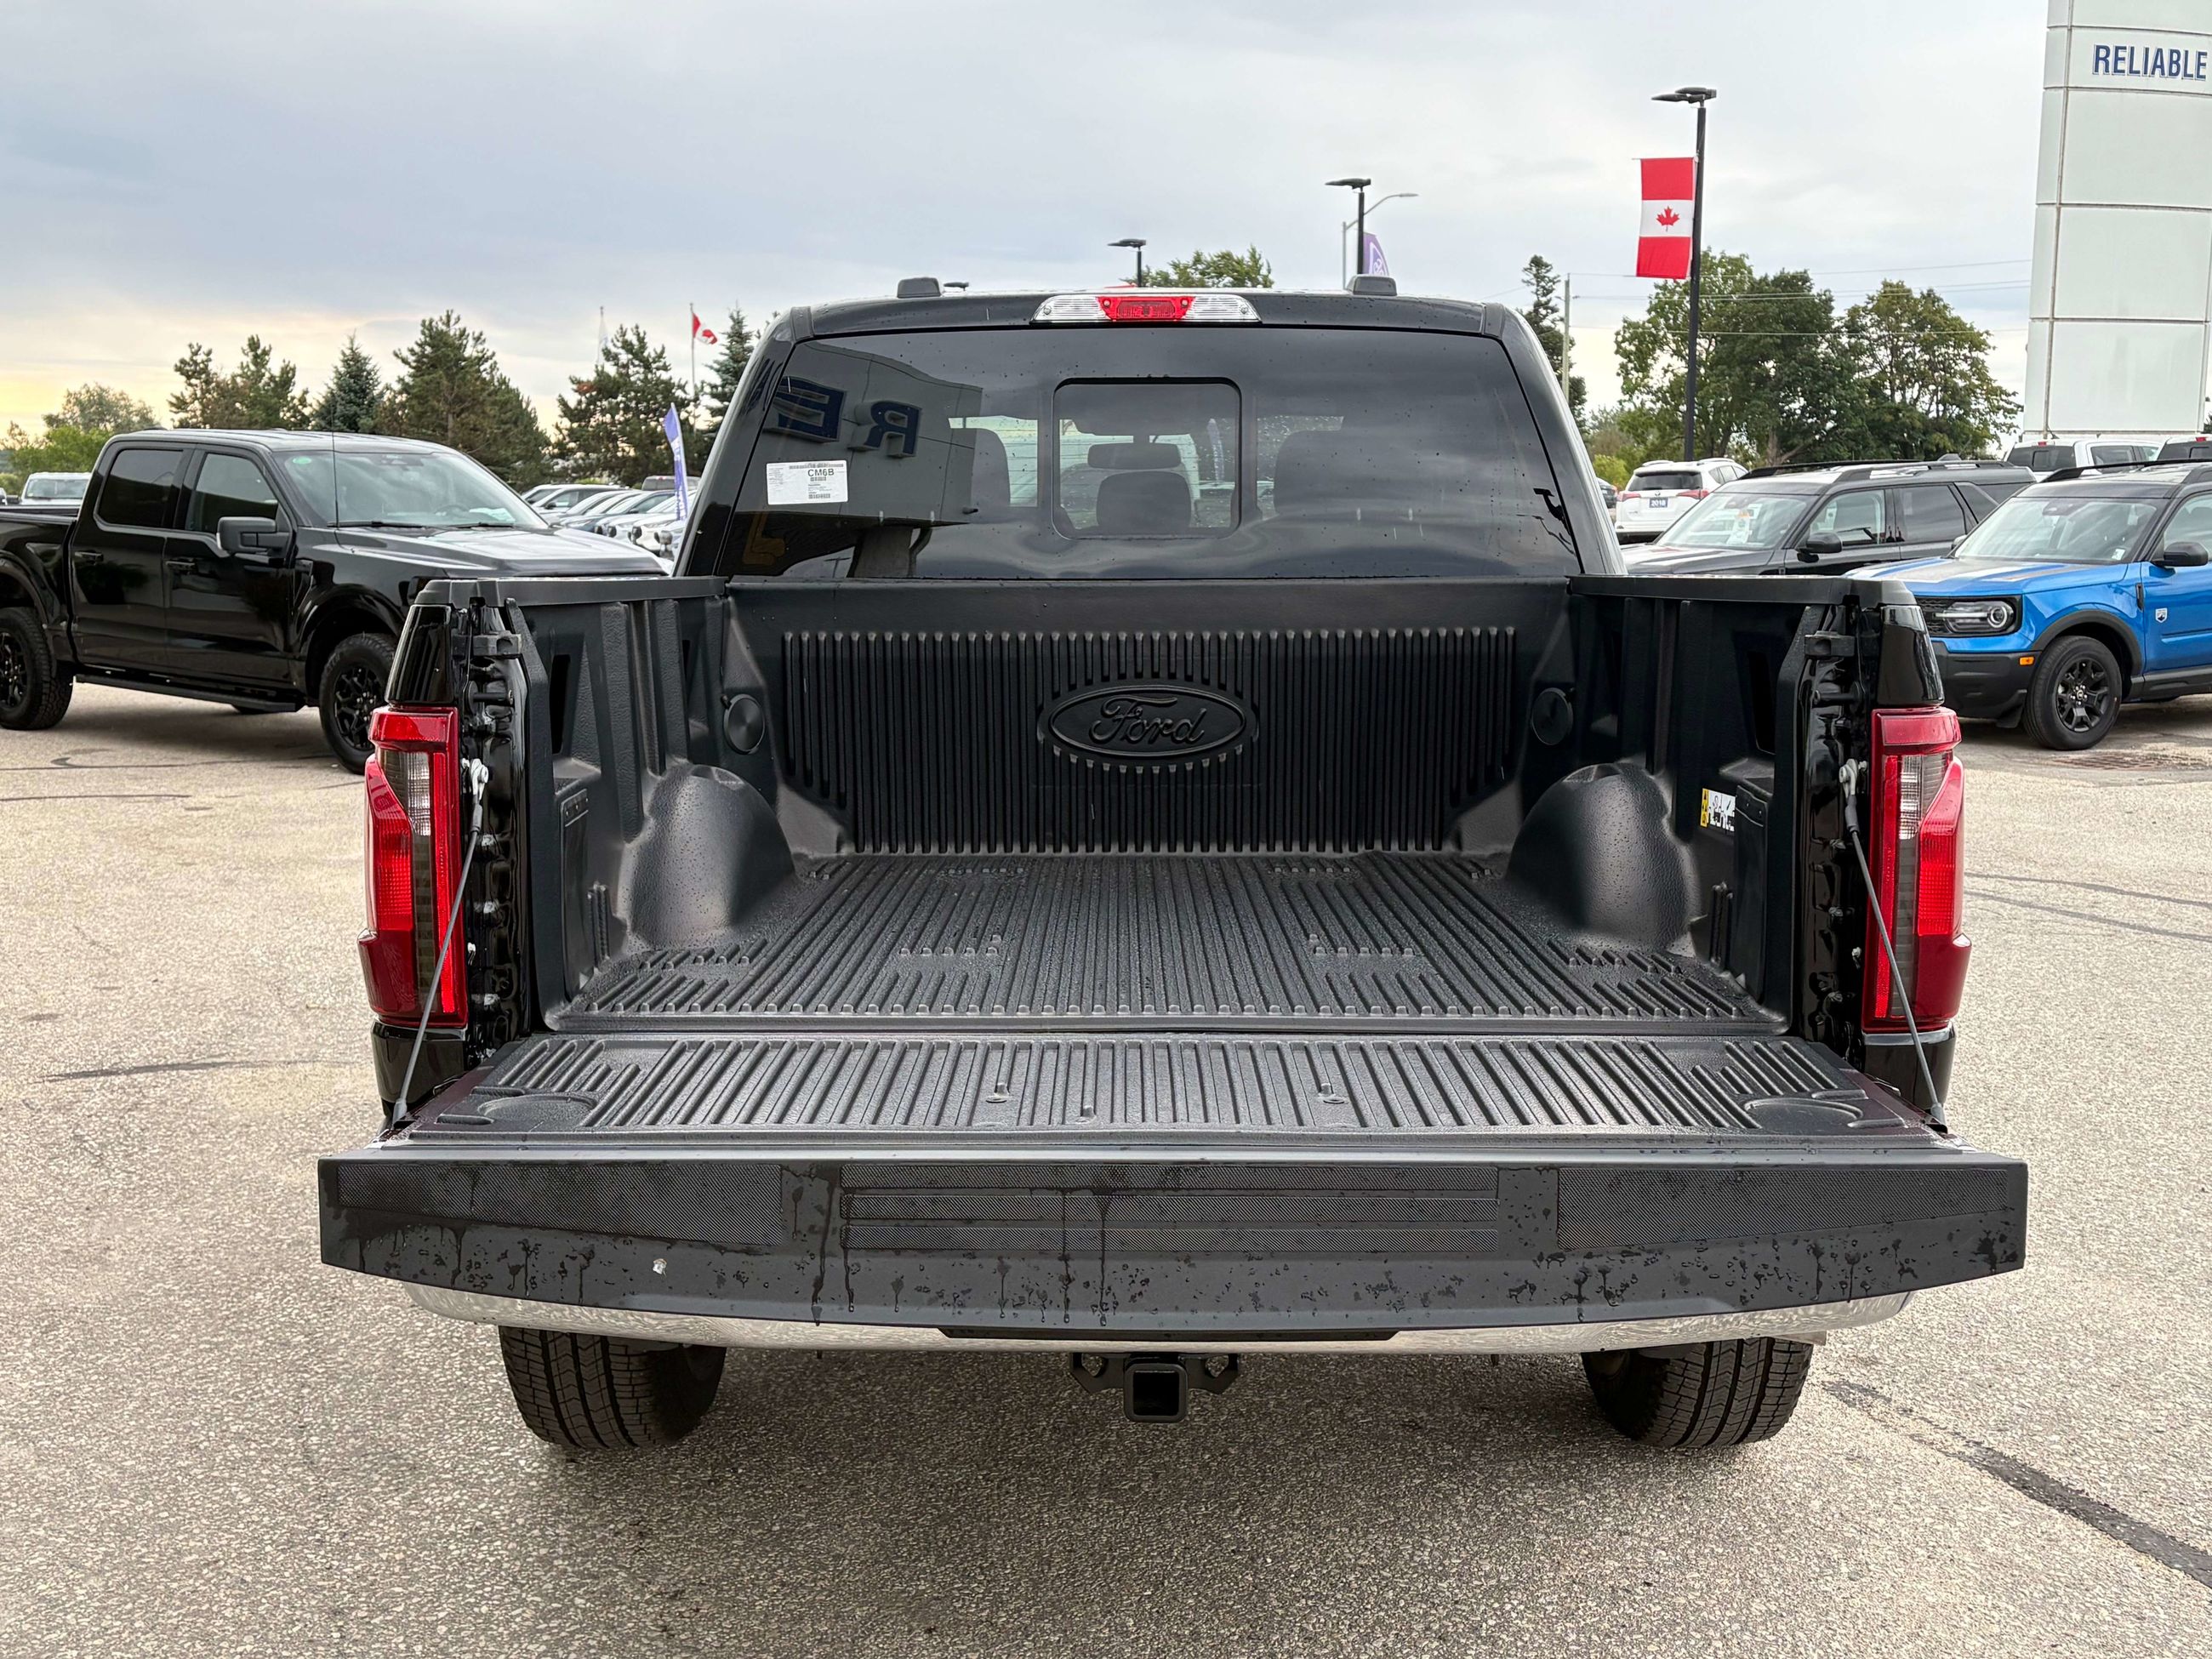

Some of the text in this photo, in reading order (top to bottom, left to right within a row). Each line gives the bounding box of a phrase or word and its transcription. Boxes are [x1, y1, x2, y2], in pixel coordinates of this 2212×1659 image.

[2092, 44, 2208, 81] RELIABLE
[807, 468, 835, 476] CM6B
[1089, 693, 1207, 744] Ford
